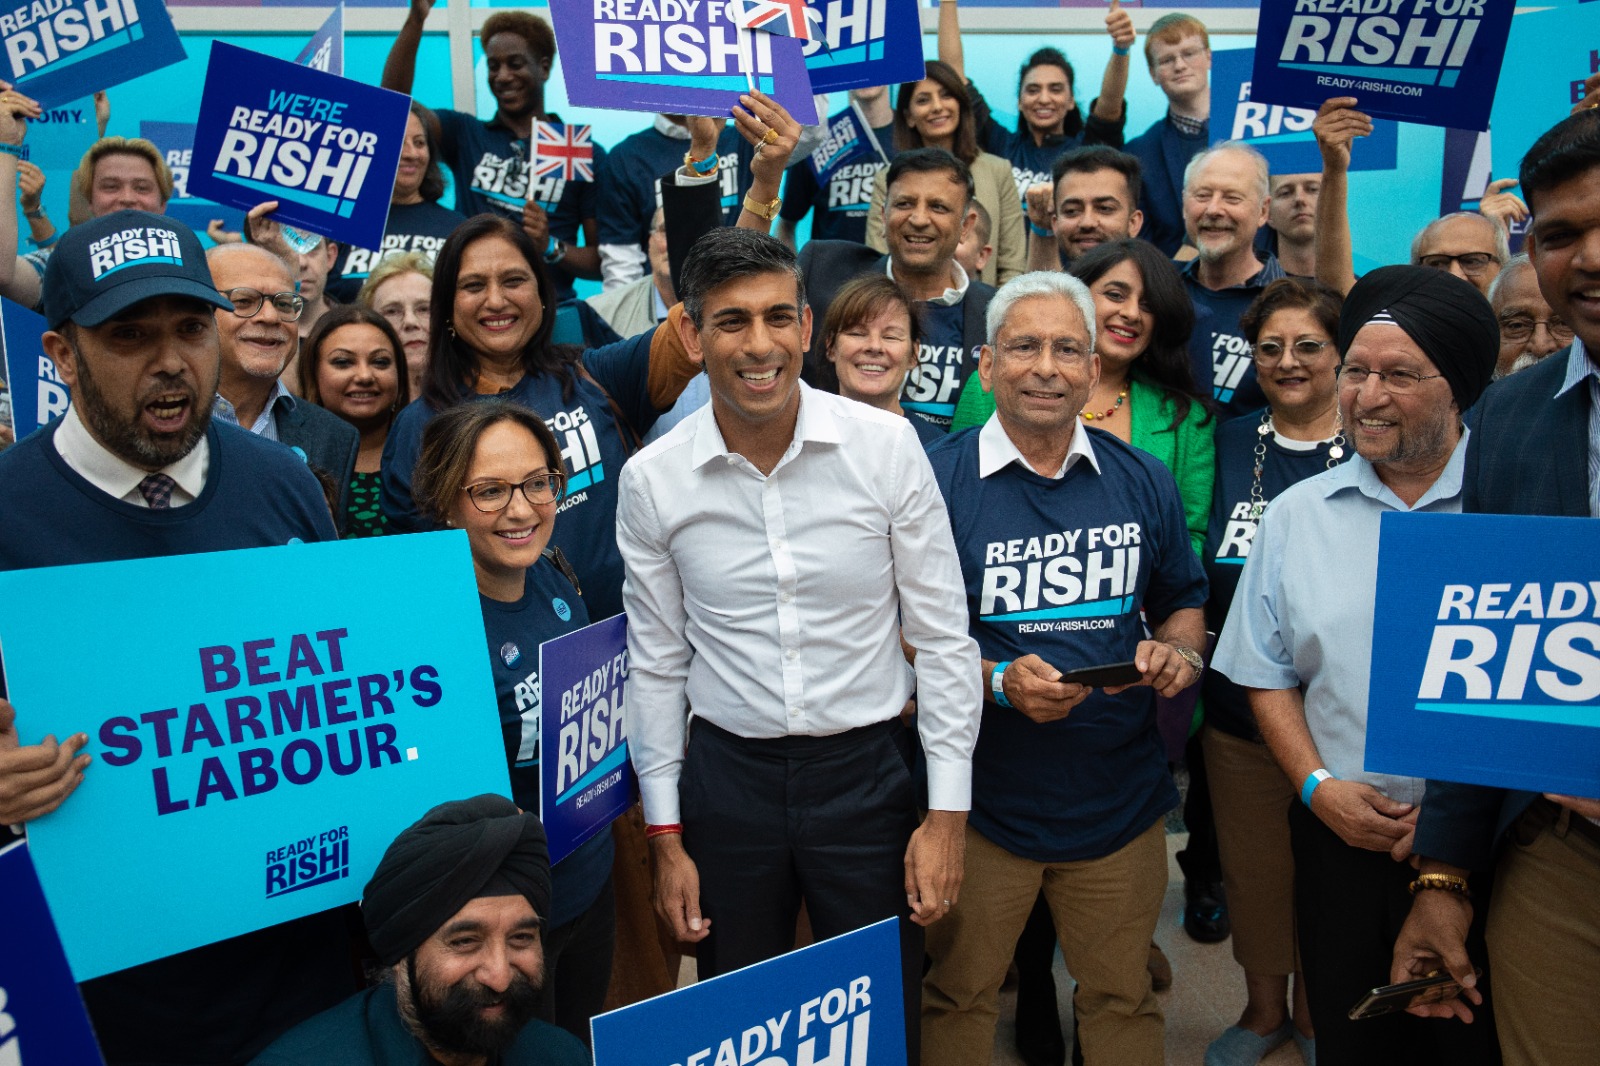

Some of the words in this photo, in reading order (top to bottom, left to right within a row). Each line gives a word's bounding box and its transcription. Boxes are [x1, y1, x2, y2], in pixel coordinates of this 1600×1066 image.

[593, 0, 701, 23] READY
[1316, 75, 1423, 97] READY4RISHI.COM
[229, 105, 322, 143] READY
[320, 124, 379, 156] FOR
[89, 227, 144, 255] READY
[146, 227, 178, 241] FOR
[985, 528, 1083, 566] READY
[1088, 522, 1141, 550] FOR
[1018, 619, 1115, 634] READY4RISHI.COM
[199, 628, 349, 694] BEAT
[98, 664, 443, 767] STARMER'S
[560, 660, 611, 725] READY
[151, 723, 418, 816] LABOUR.
[266, 835, 316, 865] READY
[319, 825, 349, 847] FOR
[798, 975, 872, 1039] FOR
